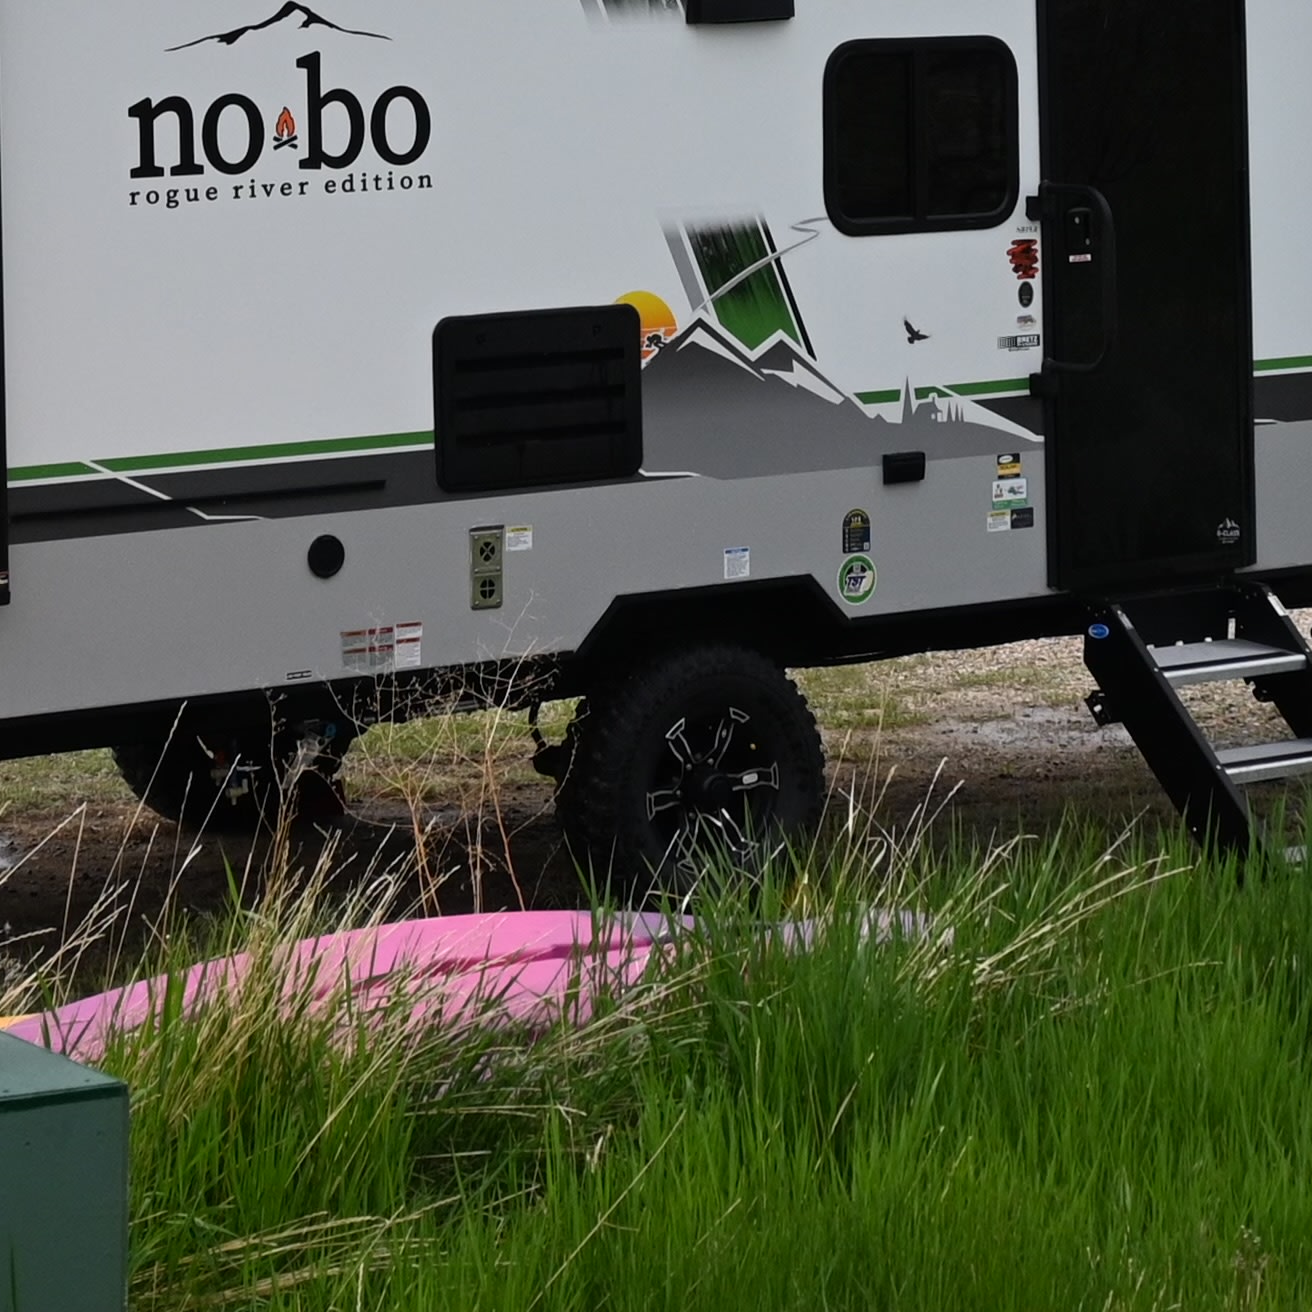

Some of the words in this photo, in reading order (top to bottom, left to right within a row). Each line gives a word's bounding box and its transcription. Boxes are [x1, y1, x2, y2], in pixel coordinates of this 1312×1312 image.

[129, 187, 218, 209] rogue
[232, 179, 309, 199] river
[324, 171, 433, 193] edition
